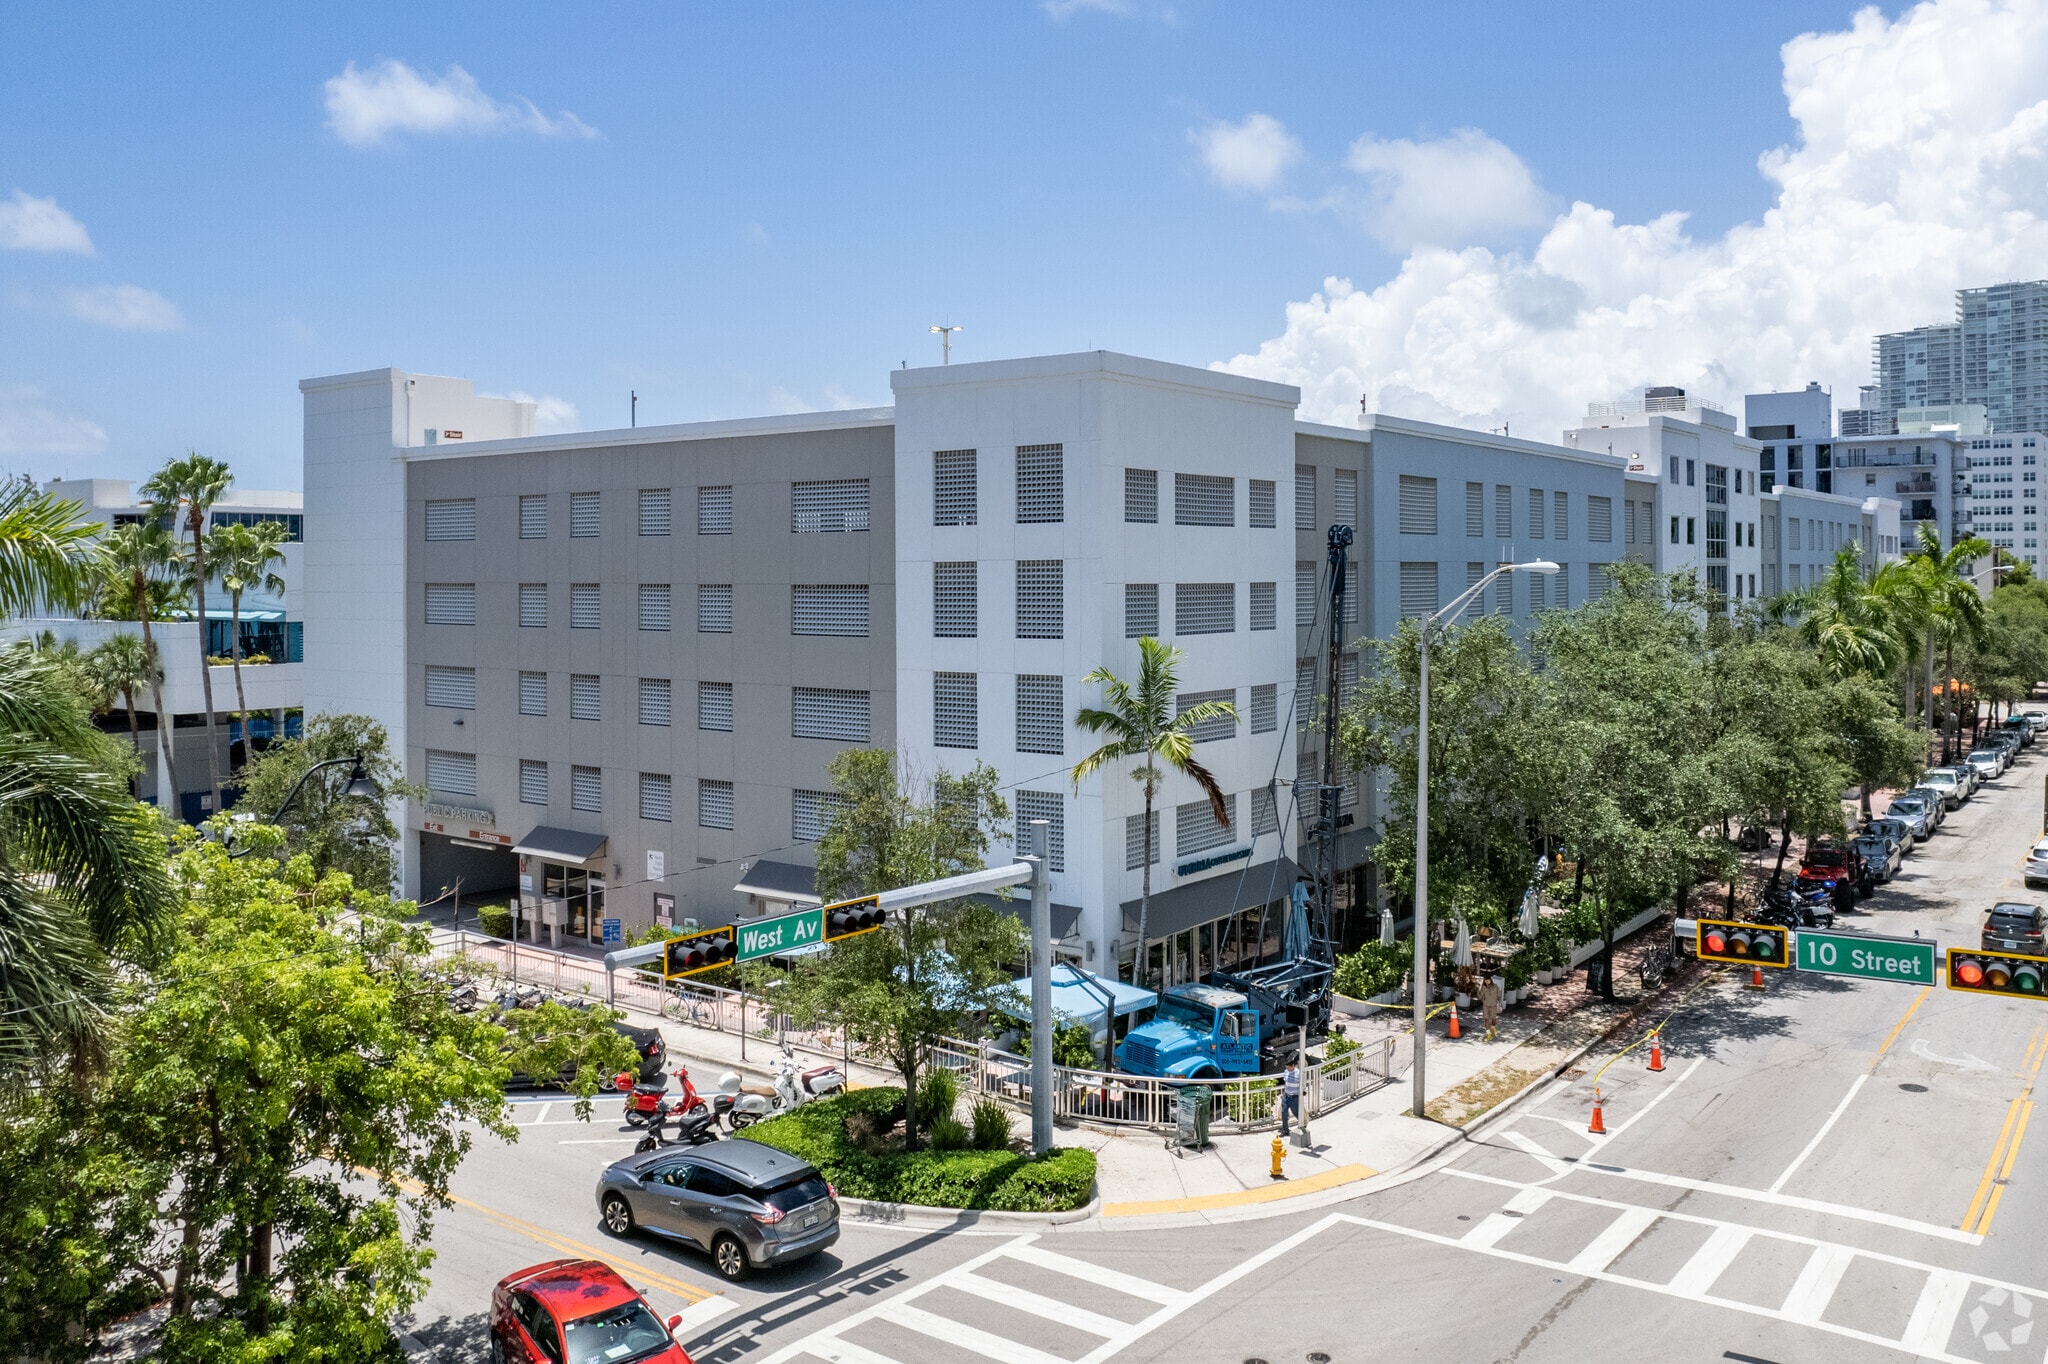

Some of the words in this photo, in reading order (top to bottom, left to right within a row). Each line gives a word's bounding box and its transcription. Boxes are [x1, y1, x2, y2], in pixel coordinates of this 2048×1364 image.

[423, 804, 451, 818] PUBLIC
[451, 807, 489, 824] PARKING
[744, 925, 783, 953] West
[794, 920, 818, 941] Av
[1807, 941, 1837, 966] 10
[1851, 949, 1921, 975] Street
